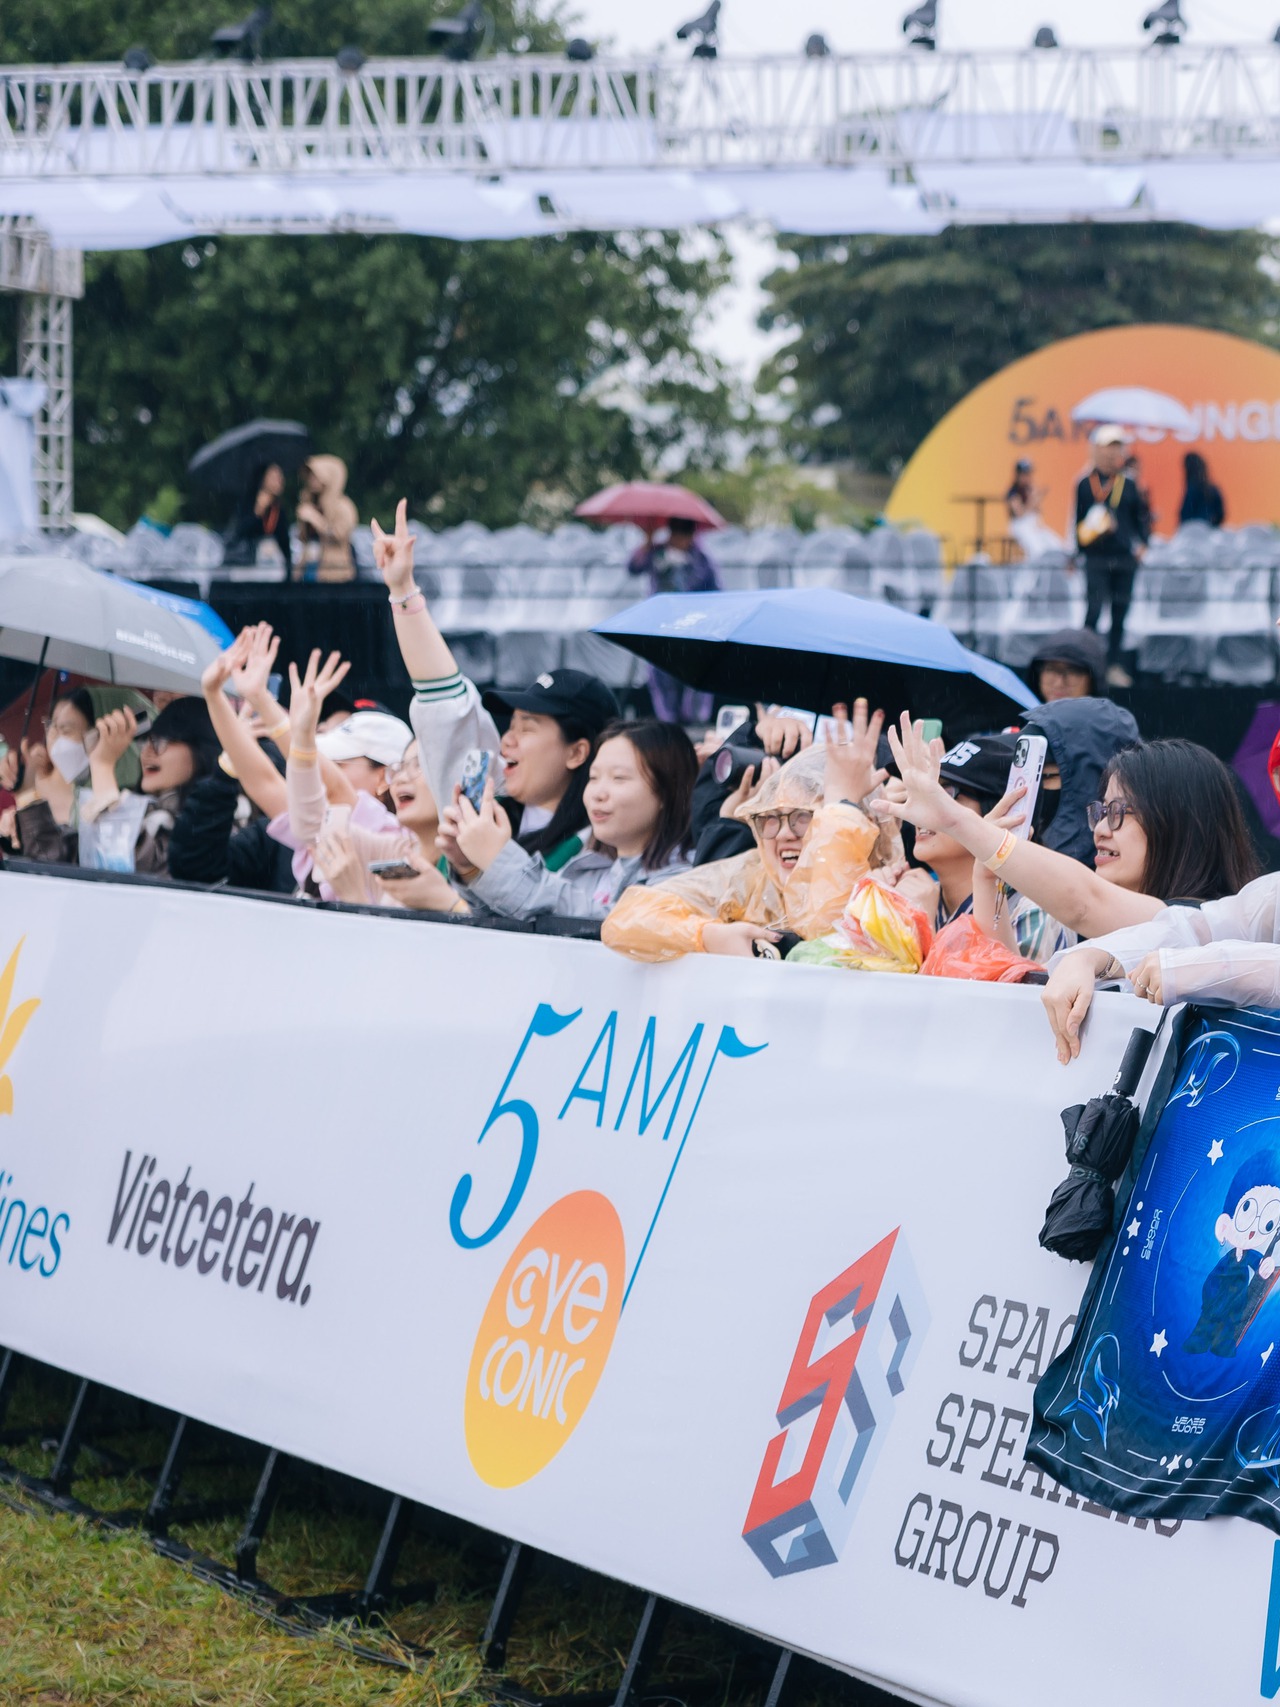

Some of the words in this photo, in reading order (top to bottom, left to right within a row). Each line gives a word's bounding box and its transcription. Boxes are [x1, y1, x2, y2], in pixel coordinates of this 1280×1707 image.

[0, 1169, 70, 1278] ines
[107, 1149, 321, 1307] Vietcetera.
[894, 1492, 1060, 1609] GROUP
